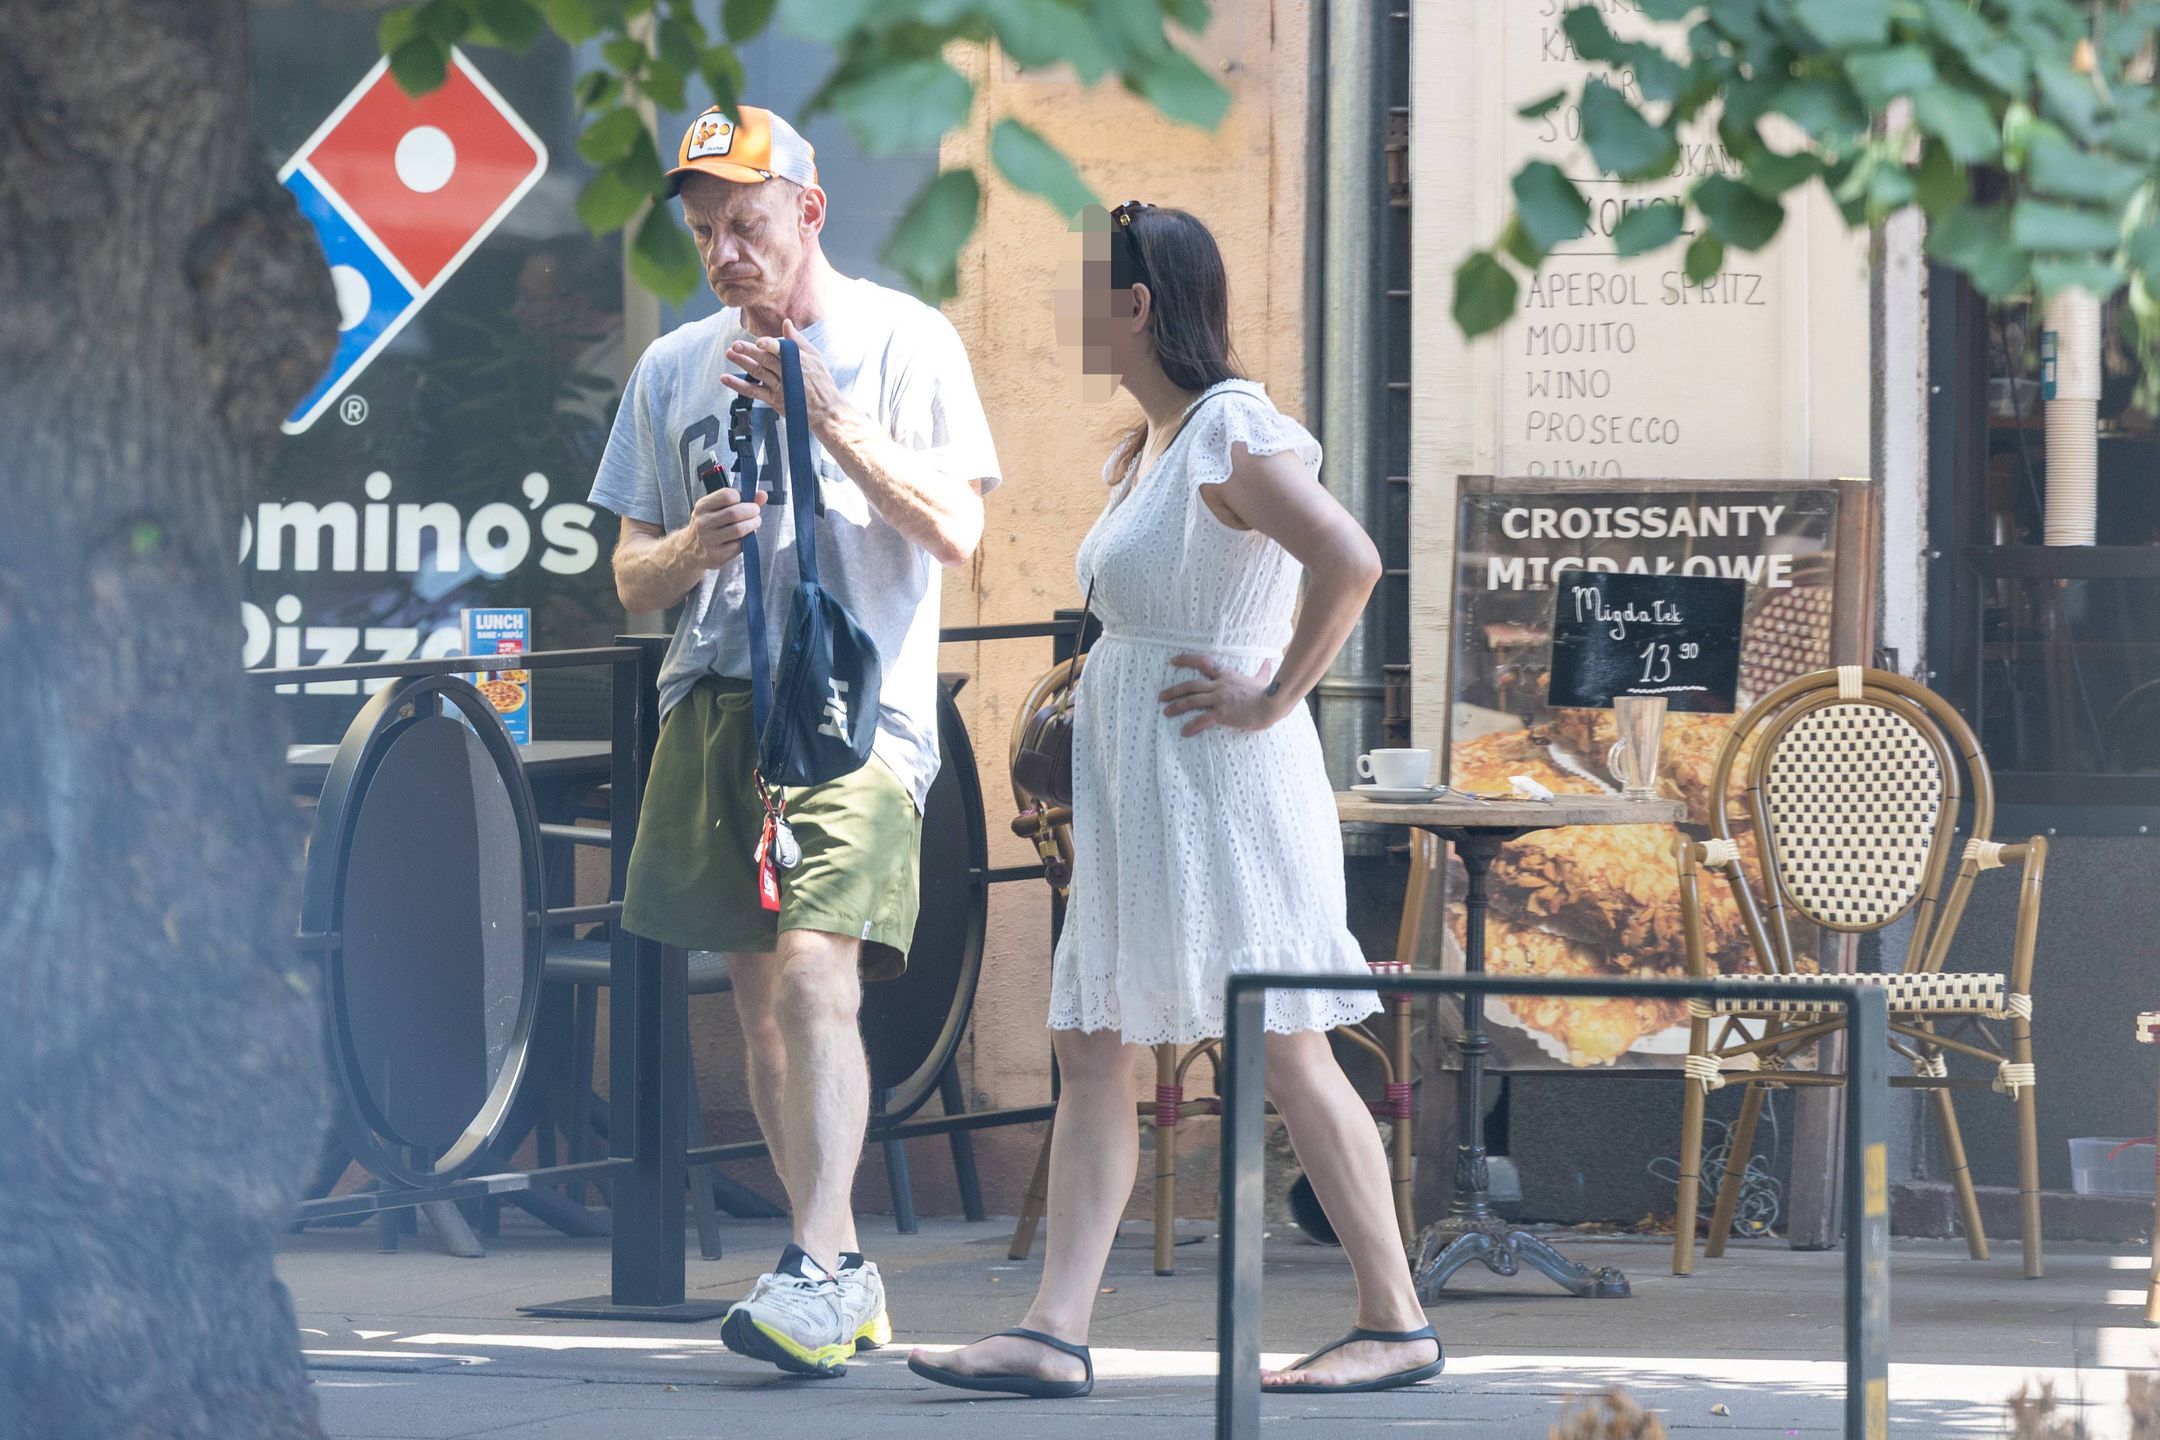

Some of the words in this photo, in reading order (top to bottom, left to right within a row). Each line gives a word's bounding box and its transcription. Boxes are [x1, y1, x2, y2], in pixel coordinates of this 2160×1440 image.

[1524, 273, 1648, 309] APEROL
[1660, 271, 1765, 306] SPRITZ
[1525, 322, 1636, 356] MOJITO
[1526, 369, 1612, 399] WINO
[1525, 410, 1680, 445] PROSECCO
[239, 471, 599, 575] mino's
[1502, 505, 1786, 539] CROISSANTY
[475, 614, 523, 630] LUNCH
[1638, 641, 1673, 683] 13
[1678, 642, 1700, 660] 90
